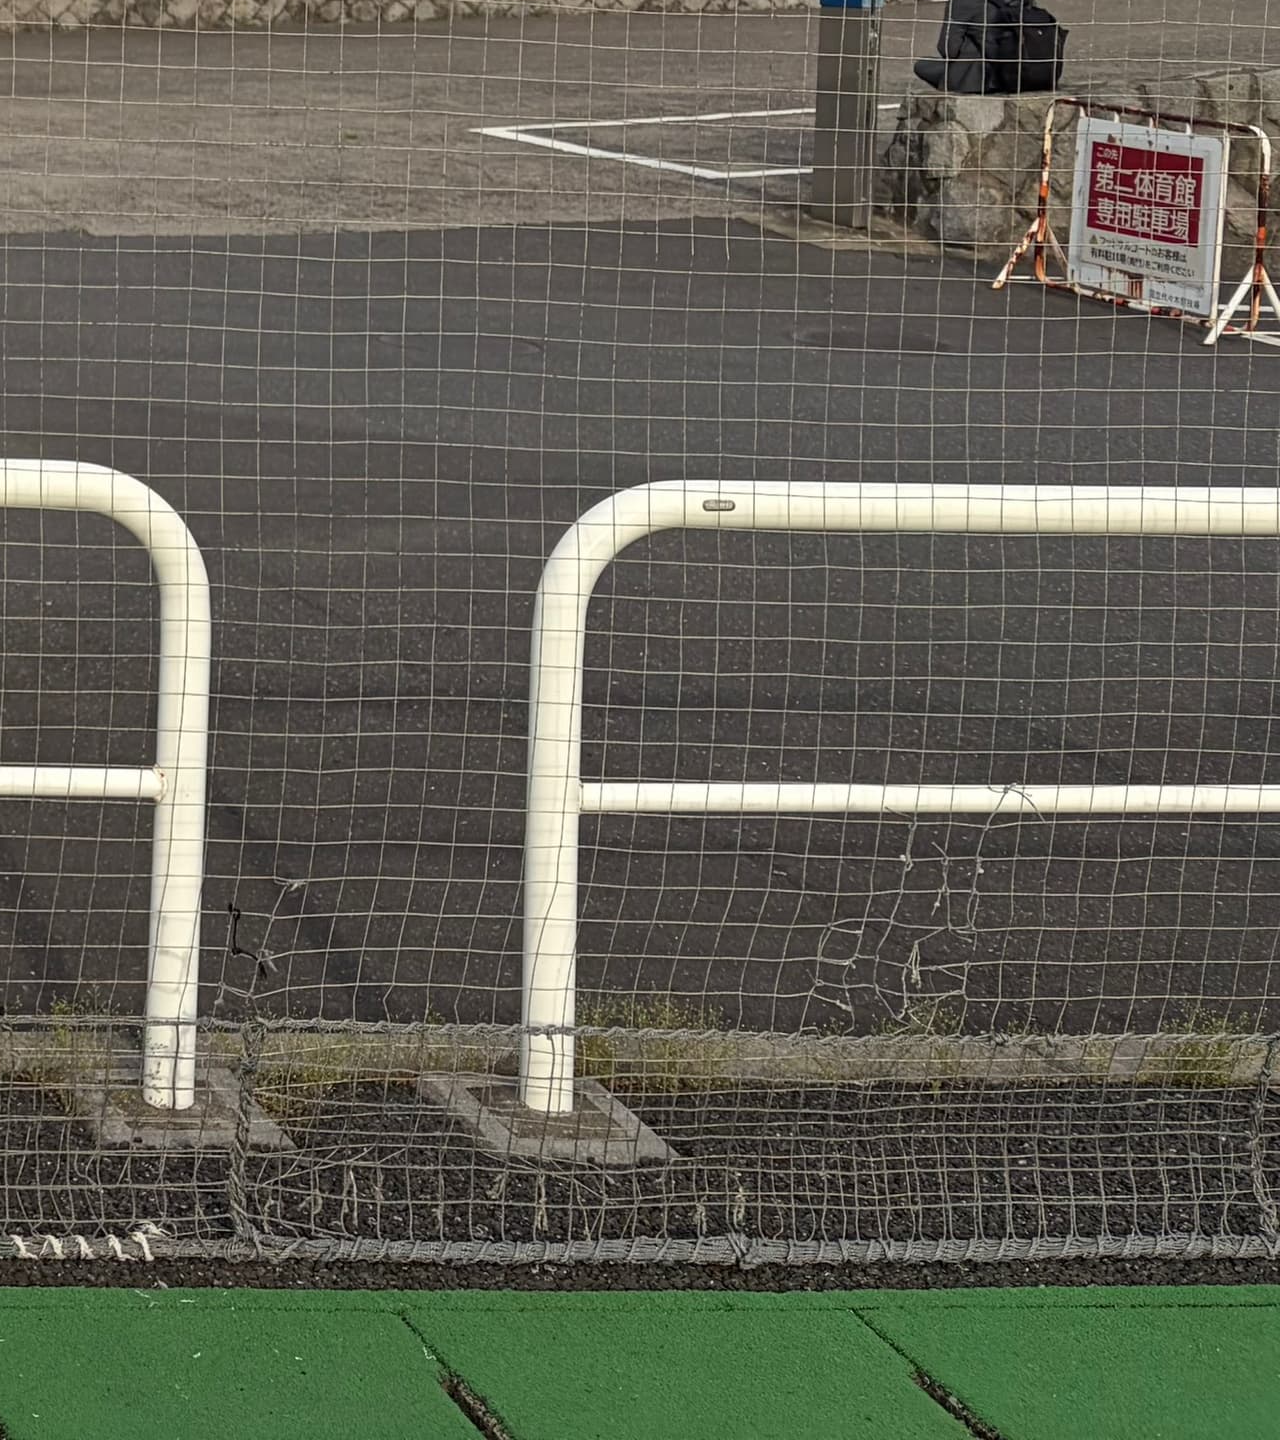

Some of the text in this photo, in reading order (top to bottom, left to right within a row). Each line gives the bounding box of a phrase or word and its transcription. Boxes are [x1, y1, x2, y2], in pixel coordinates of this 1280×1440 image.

[1094, 162, 1197, 208] 第二体育館
[1095, 197, 1189, 240] 専用駐車場
